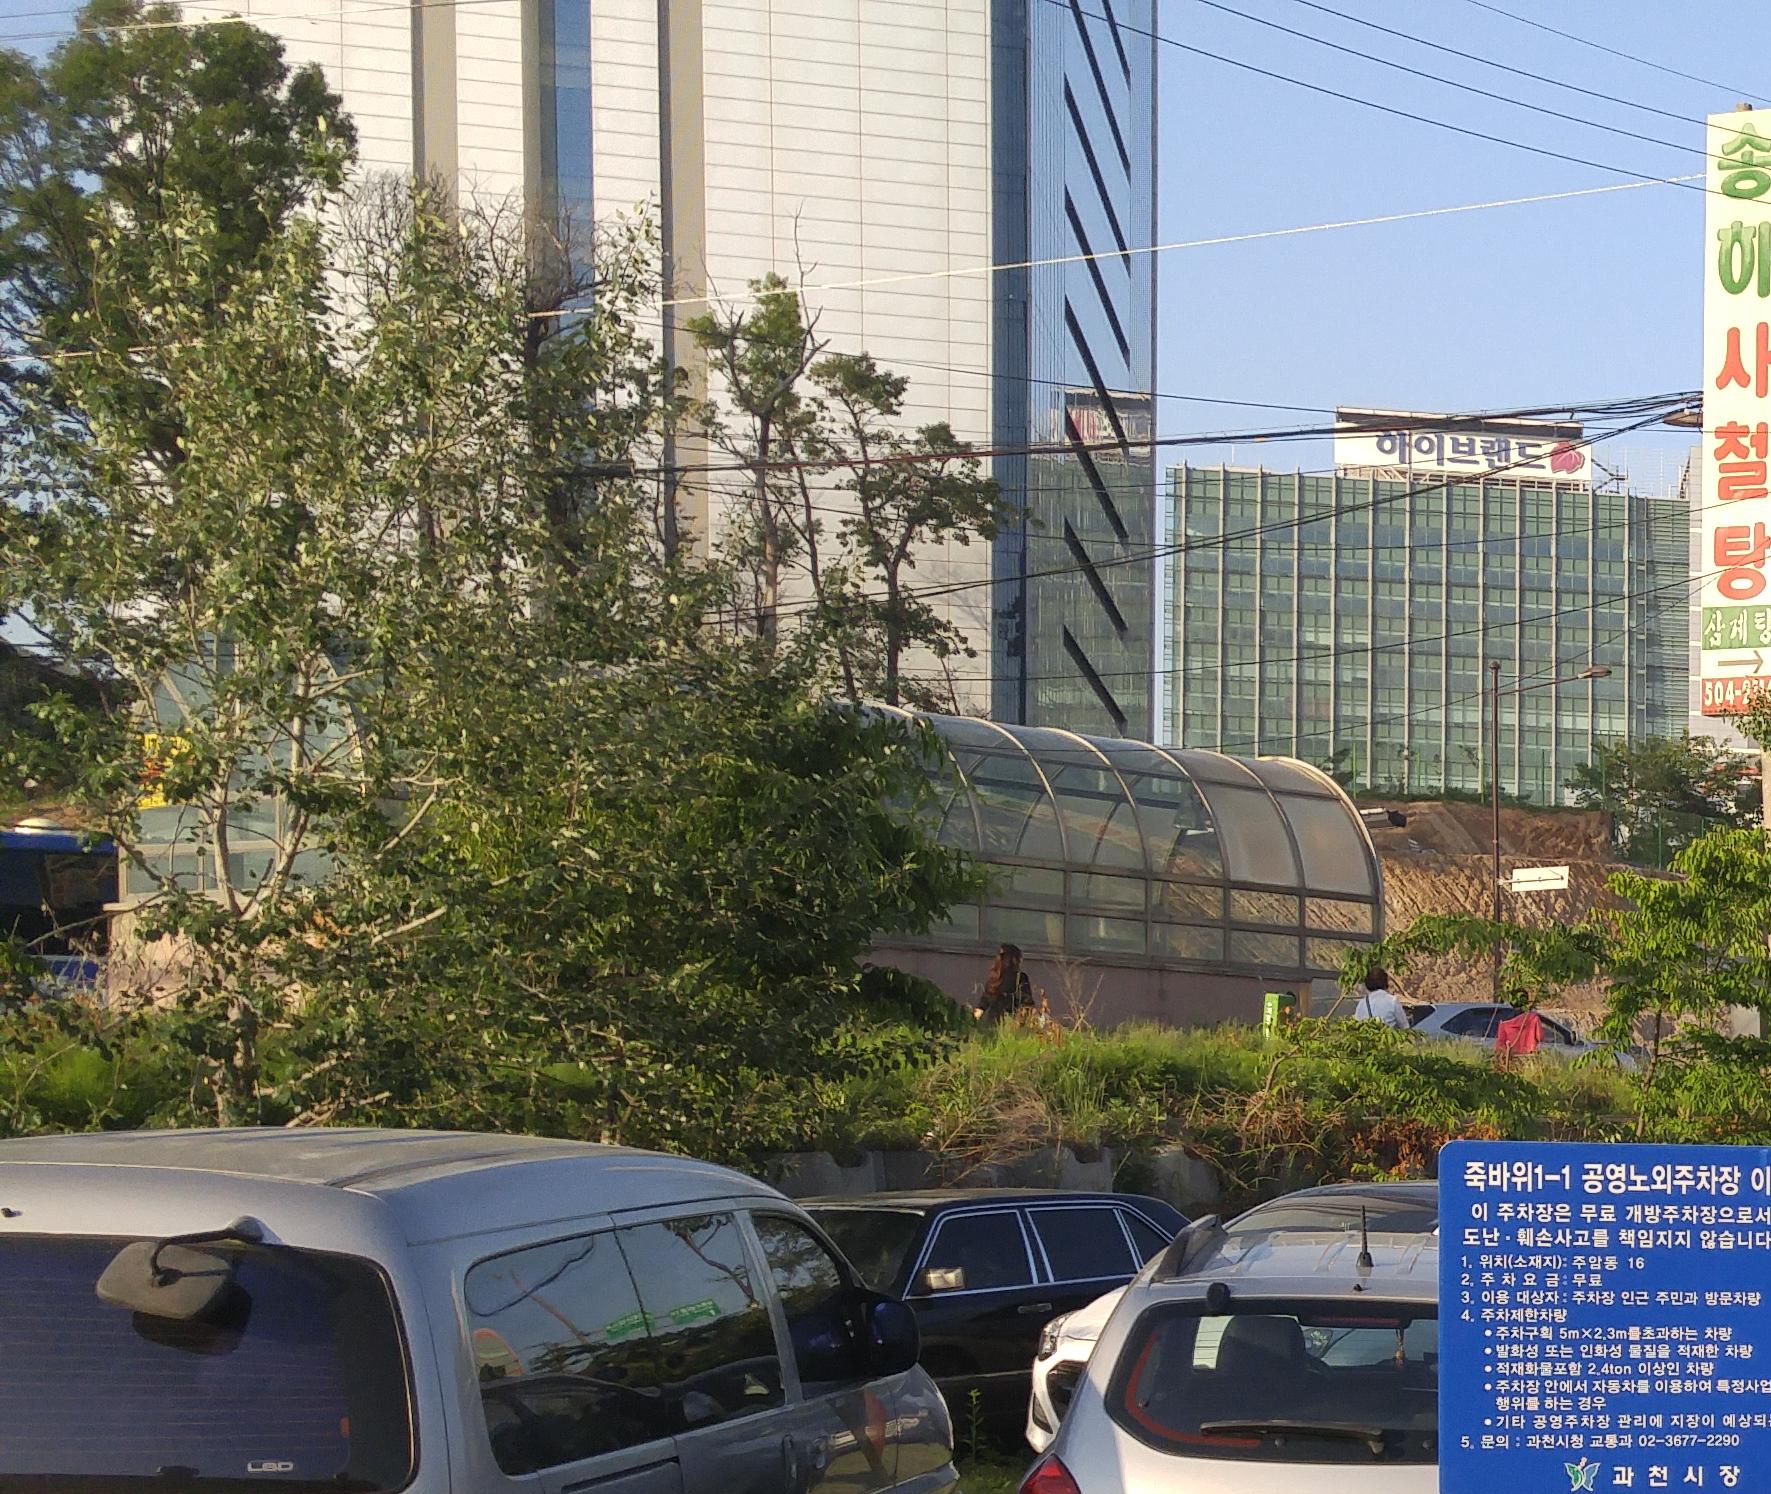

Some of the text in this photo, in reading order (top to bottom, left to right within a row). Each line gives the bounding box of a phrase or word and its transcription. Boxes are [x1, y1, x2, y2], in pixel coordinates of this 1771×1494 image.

[1375, 431, 1547, 470] 하이브랜드
[1463, 1161, 1570, 1193] 죽바위1-1
[1581, 1163, 1742, 1196] 공영노외주차장
[1471, 1202, 1488, 1222] 이
[1496, 1202, 1572, 1223] 주차장은
[1579, 1204, 1617, 1224] 무료
[1625, 1204, 1771, 1226] 개방주차장으로서
[1618, 1228, 1691, 1249] 책임지지
[1461, 1255, 1473, 1269] 1.
[1571, 1255, 1619, 1271] 주암동
[1628, 1256, 1645, 1270] 16
[1460, 1272, 1474, 1287] 2.
[1572, 1273, 1603, 1288] 무료
[1460, 1290, 1475, 1305] 3.
[1481, 1289, 1510, 1305] 이용
[1571, 1290, 1616, 1306] 주차장
[1620, 1290, 1650, 1306] 인근
[1655, 1291, 1699, 1306] 주민과
[1704, 1291, 1762, 1307] 방문차량
[1460, 1307, 1568, 1323] 4. 주차제한차량
[1495, 1325, 1553, 1341] 주차구획
[1704, 1326, 1733, 1342] 차량
[1495, 1343, 1754, 1359] 발화성 또는 인화성 물질을 적재한 차량
[1496, 1361, 1715, 1377] 적재화물포함 2.4ton 이상인 차량
[1495, 1379, 1541, 1395] 주차장
[1544, 1379, 1588, 1394] 안에서
[1591, 1379, 1651, 1394] 자동차를
[1654, 1379, 1712, 1394] 이용하여
[1495, 1396, 1607, 1412] 행위를 하는 경우
[1496, 1414, 1526, 1430] 기타
[1532, 1414, 1611, 1430] 공영주차장
[1617, 1414, 1663, 1429] 관리에
[1670, 1413, 1715, 1429] 지장이
[1460, 1435, 1475, 1450] 5.
[1526, 1434, 1584, 1449] 과천시청
[1589, 1433, 1633, 1449] 교통과
[1638, 1434, 1740, 1447] 02-3677-2290
